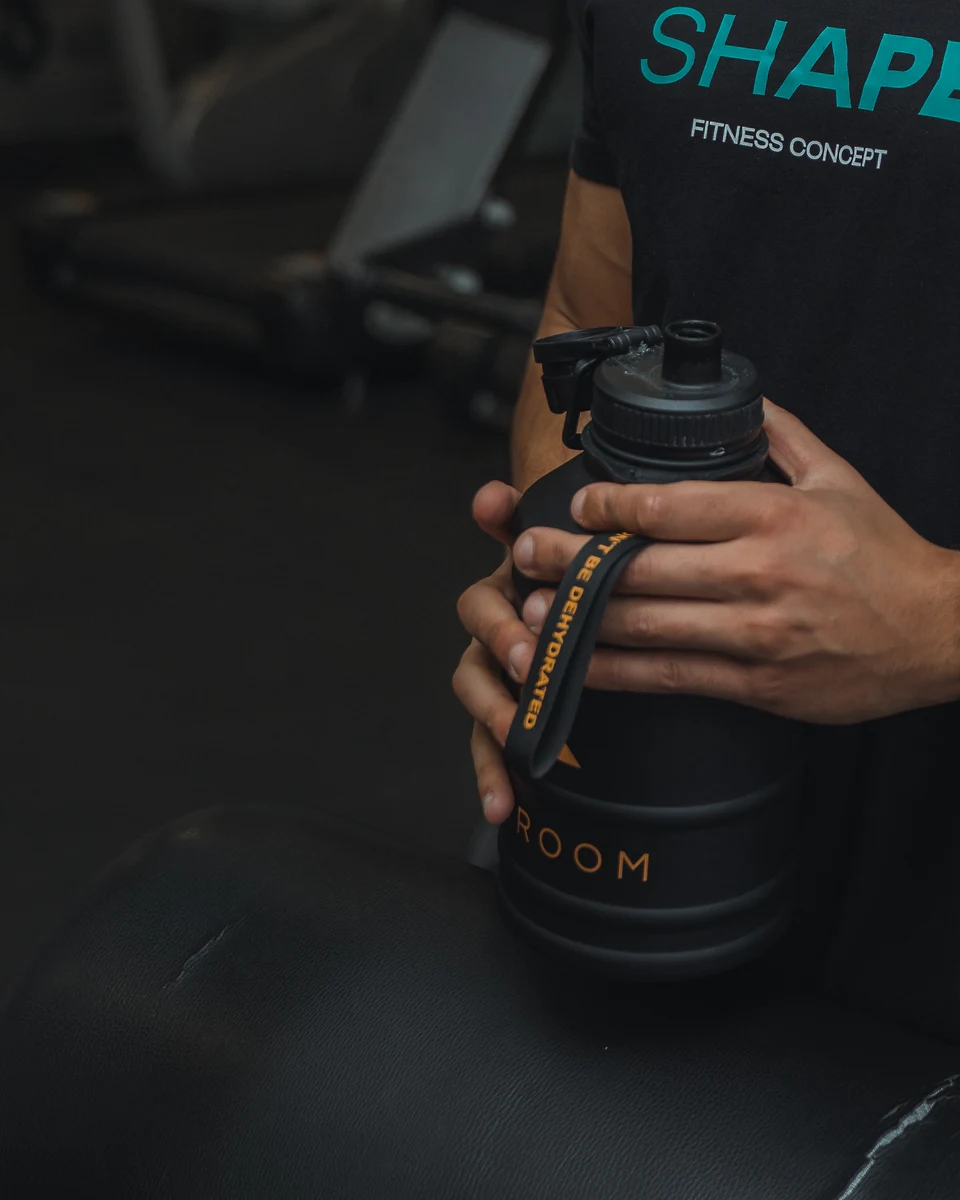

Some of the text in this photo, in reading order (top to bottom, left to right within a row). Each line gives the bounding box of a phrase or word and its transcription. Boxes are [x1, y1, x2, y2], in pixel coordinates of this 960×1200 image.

[690, 117, 888, 170] FITNESS CONCEPT
[575, 554, 602, 583] BE
[522, 585, 585, 730] DEHYDRATED
[516, 805, 650, 882] ROOM
